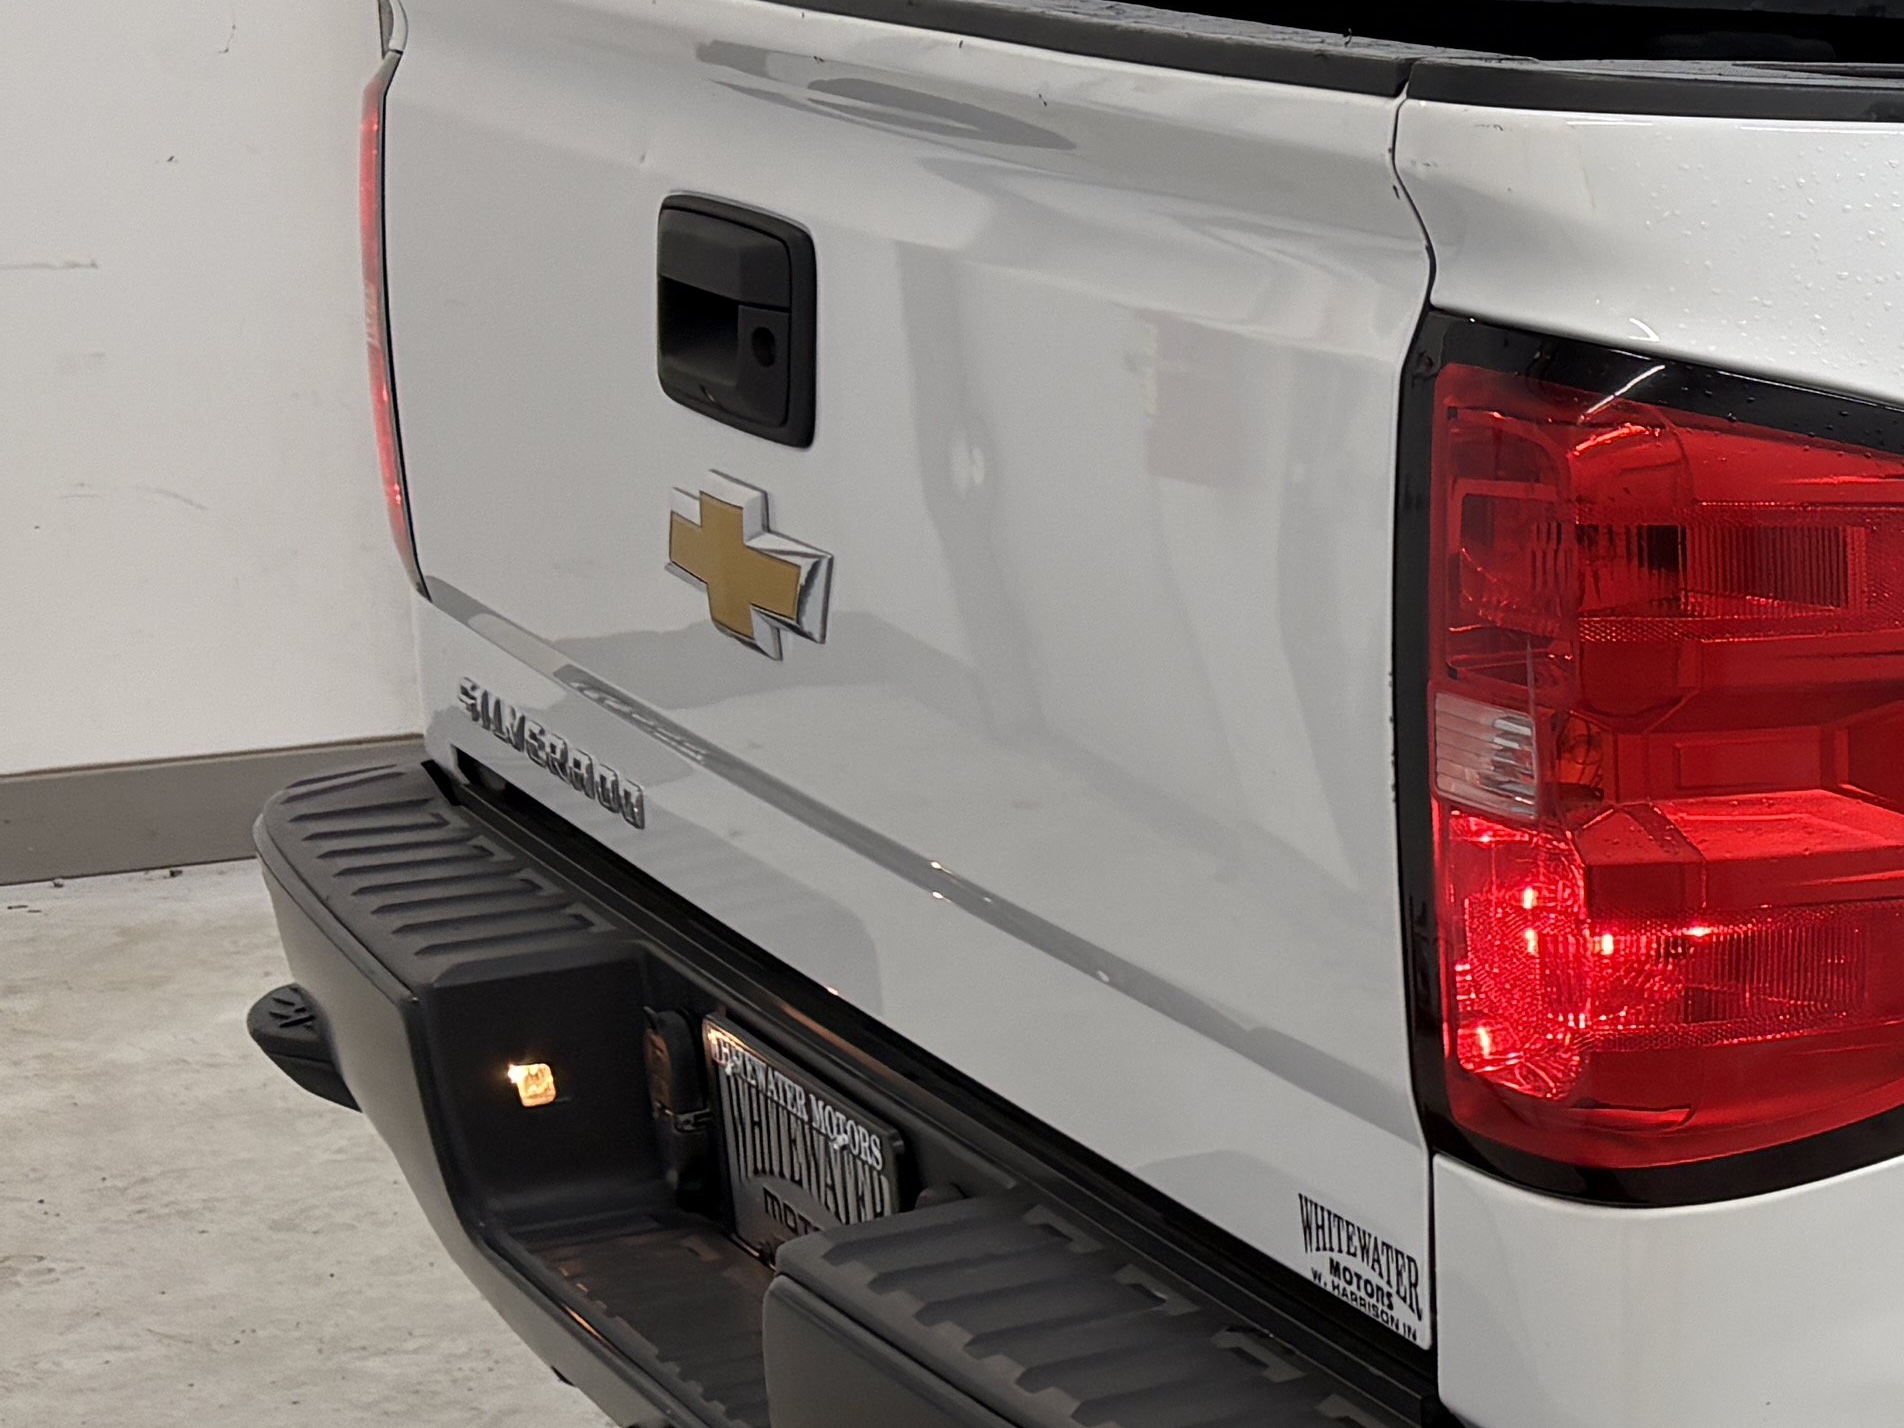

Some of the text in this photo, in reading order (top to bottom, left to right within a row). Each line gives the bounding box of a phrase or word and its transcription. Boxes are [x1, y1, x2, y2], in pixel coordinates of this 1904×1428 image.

[457, 676, 646, 830] SILVERADO
[1298, 1192, 1423, 1322] WHITEWATER
[1329, 1256, 1395, 1312] MOTORS
[1331, 1278, 1400, 1332] HARRISON
